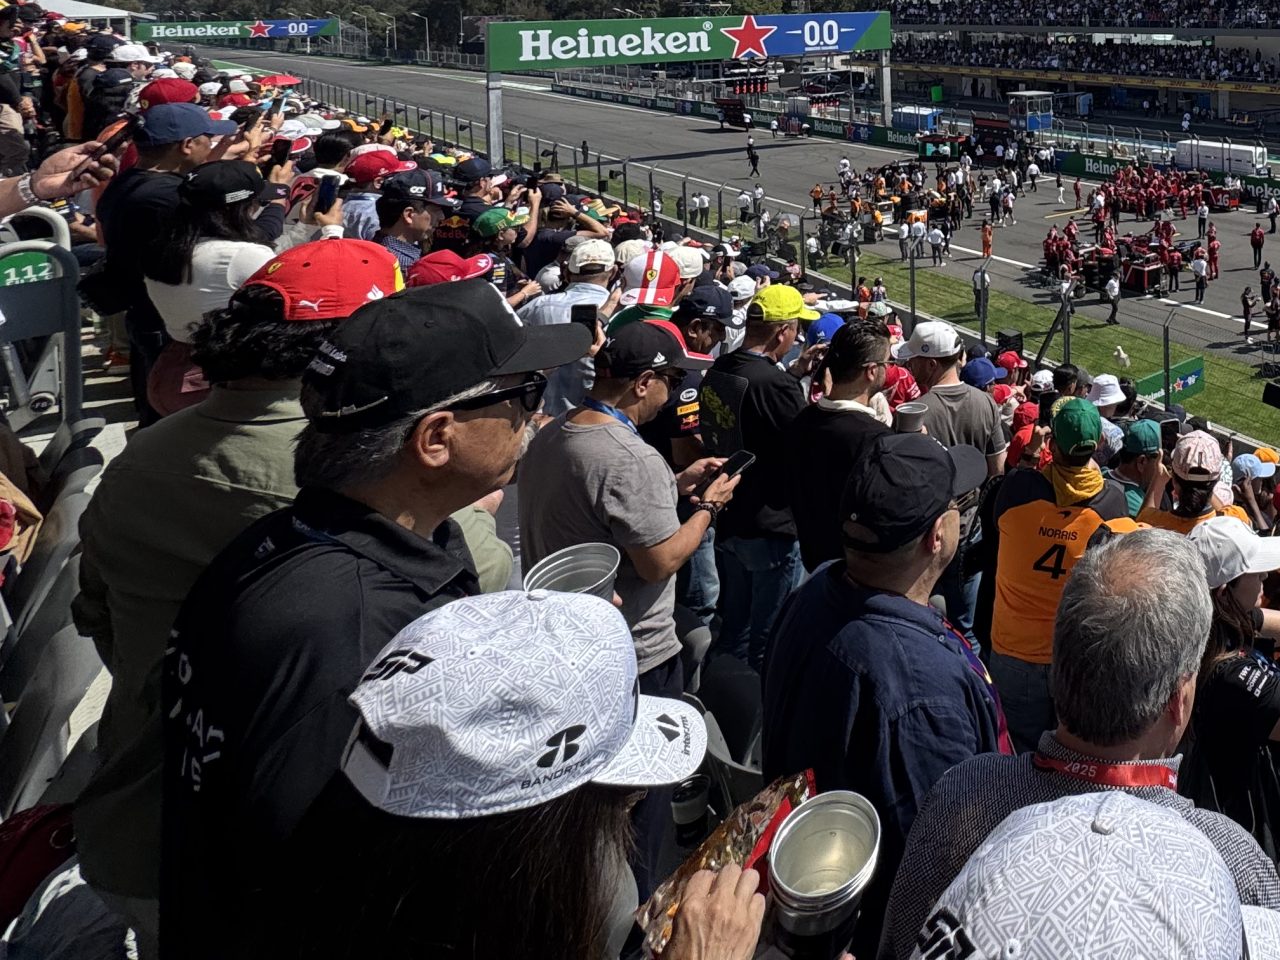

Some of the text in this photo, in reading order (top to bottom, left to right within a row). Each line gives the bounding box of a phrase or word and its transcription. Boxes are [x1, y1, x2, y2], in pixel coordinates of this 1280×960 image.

[152, 24, 240, 38] Heineken
[804, 20, 838, 46] 0.0
[518, 25, 711, 62] Heineken
[1217, 193, 1230, 206] 16
[3, 262, 52, 281] 112
[1038, 526, 1078, 541] NORRIS
[1033, 543, 1067, 579] 4
[520, 757, 589, 790] BANORTE
[1063, 761, 1098, 777] 2025
